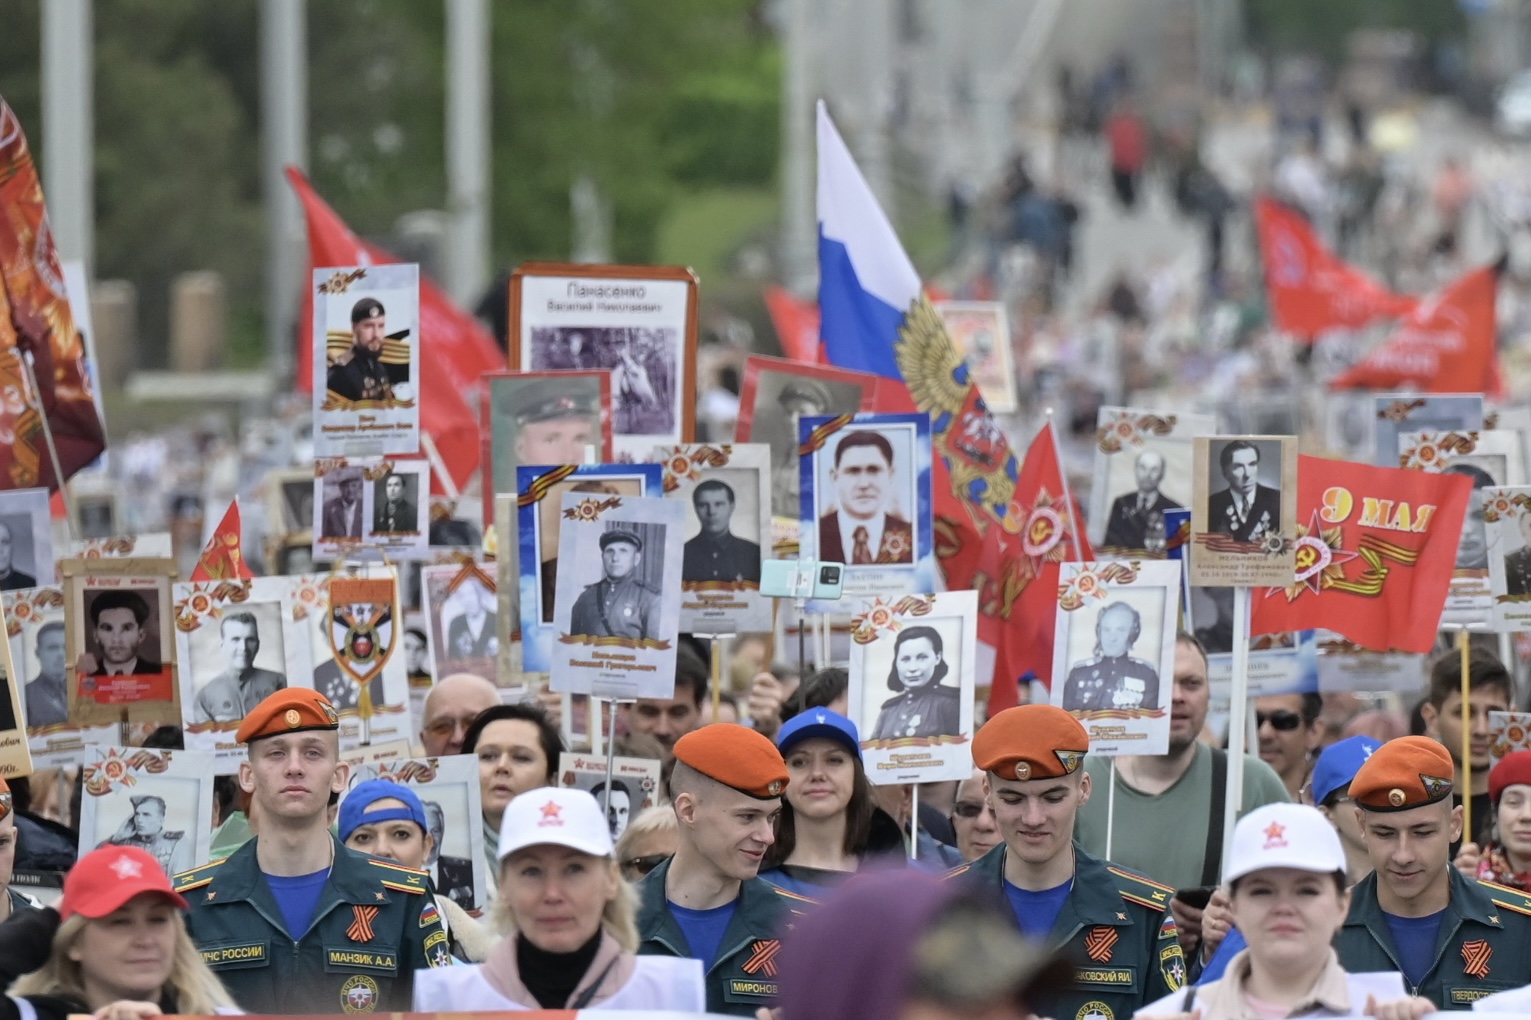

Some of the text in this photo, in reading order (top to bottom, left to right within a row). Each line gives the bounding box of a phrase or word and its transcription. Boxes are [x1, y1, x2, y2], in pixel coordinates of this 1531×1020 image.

[567, 282, 646, 299] Панасенко
[1320, 486, 1437, 533] 9 МАЯ
[201, 946, 262, 963] МЧС РОССИИ
[330, 952, 395, 968] МАНЗИК А.А.
